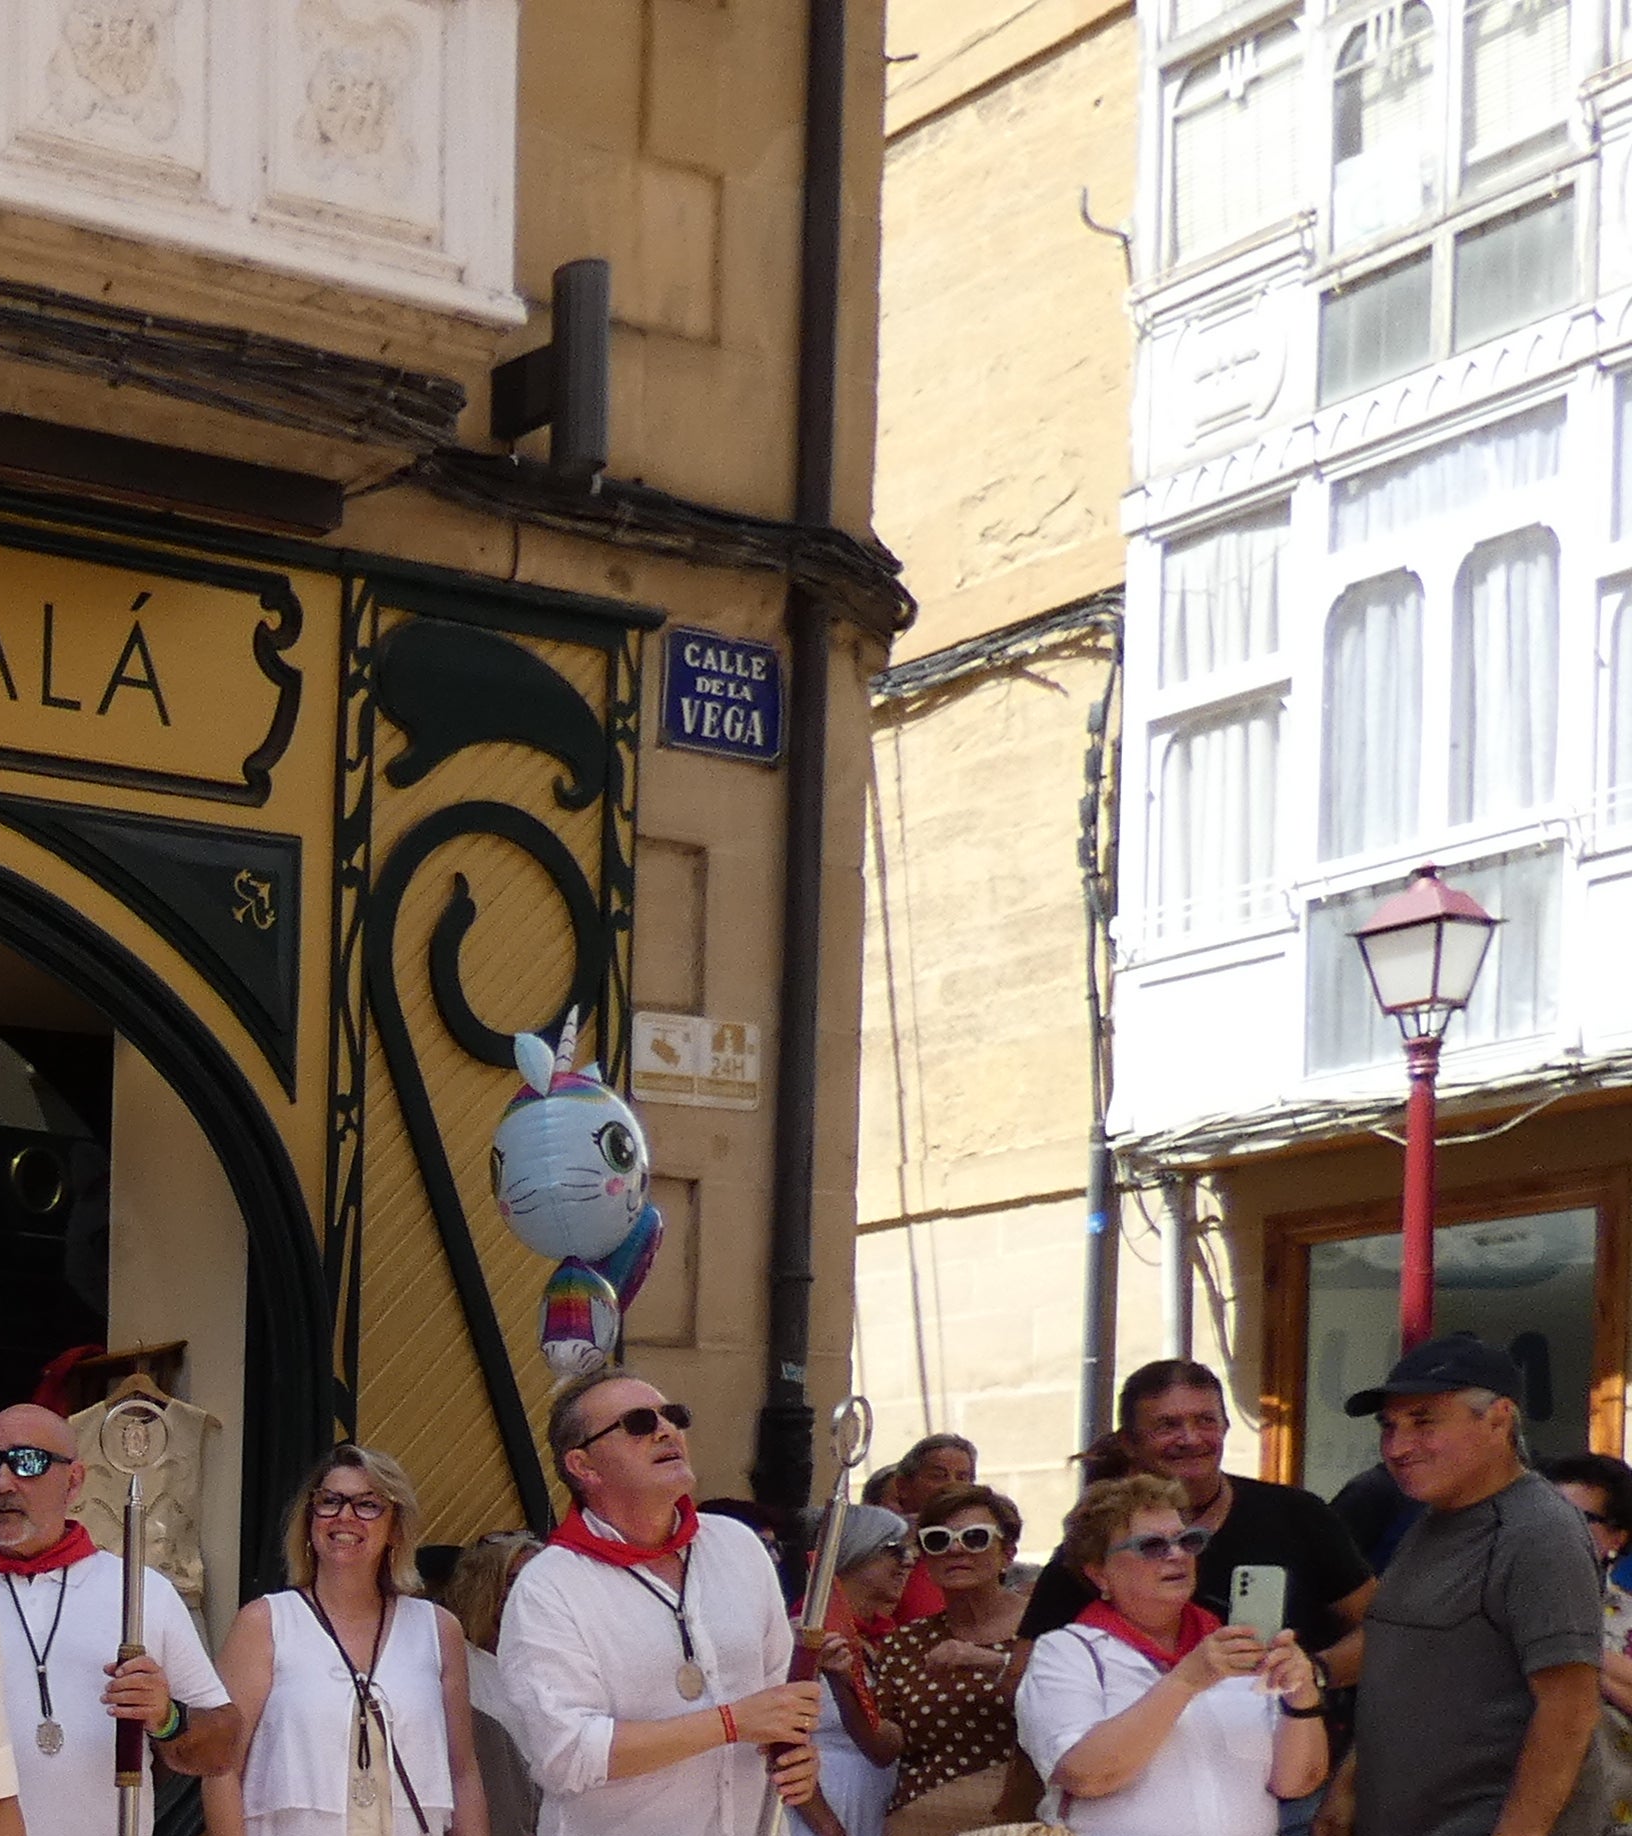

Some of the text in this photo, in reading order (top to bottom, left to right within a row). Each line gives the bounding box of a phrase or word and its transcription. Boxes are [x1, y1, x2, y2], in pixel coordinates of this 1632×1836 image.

[683, 642, 766, 681] CALLE
[696, 676, 753, 701] DE LA
[681, 697, 764, 746] VEGA
